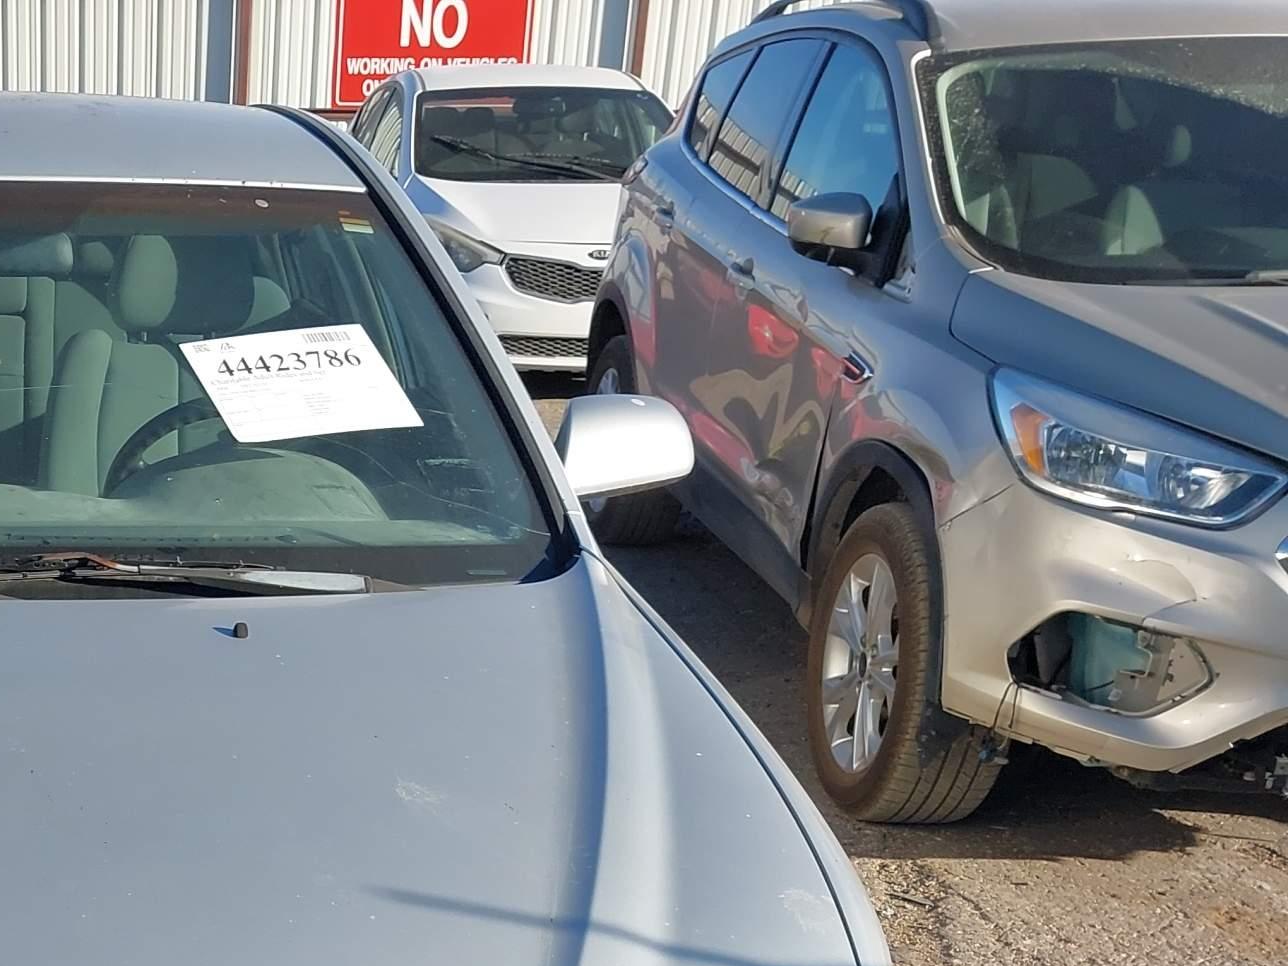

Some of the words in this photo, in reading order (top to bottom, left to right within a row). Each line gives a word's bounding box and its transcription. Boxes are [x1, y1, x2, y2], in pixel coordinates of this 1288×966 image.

[399, 0, 470, 49] NO
[346, 57, 416, 75] WORKING
[217, 348, 362, 376] 44423786
